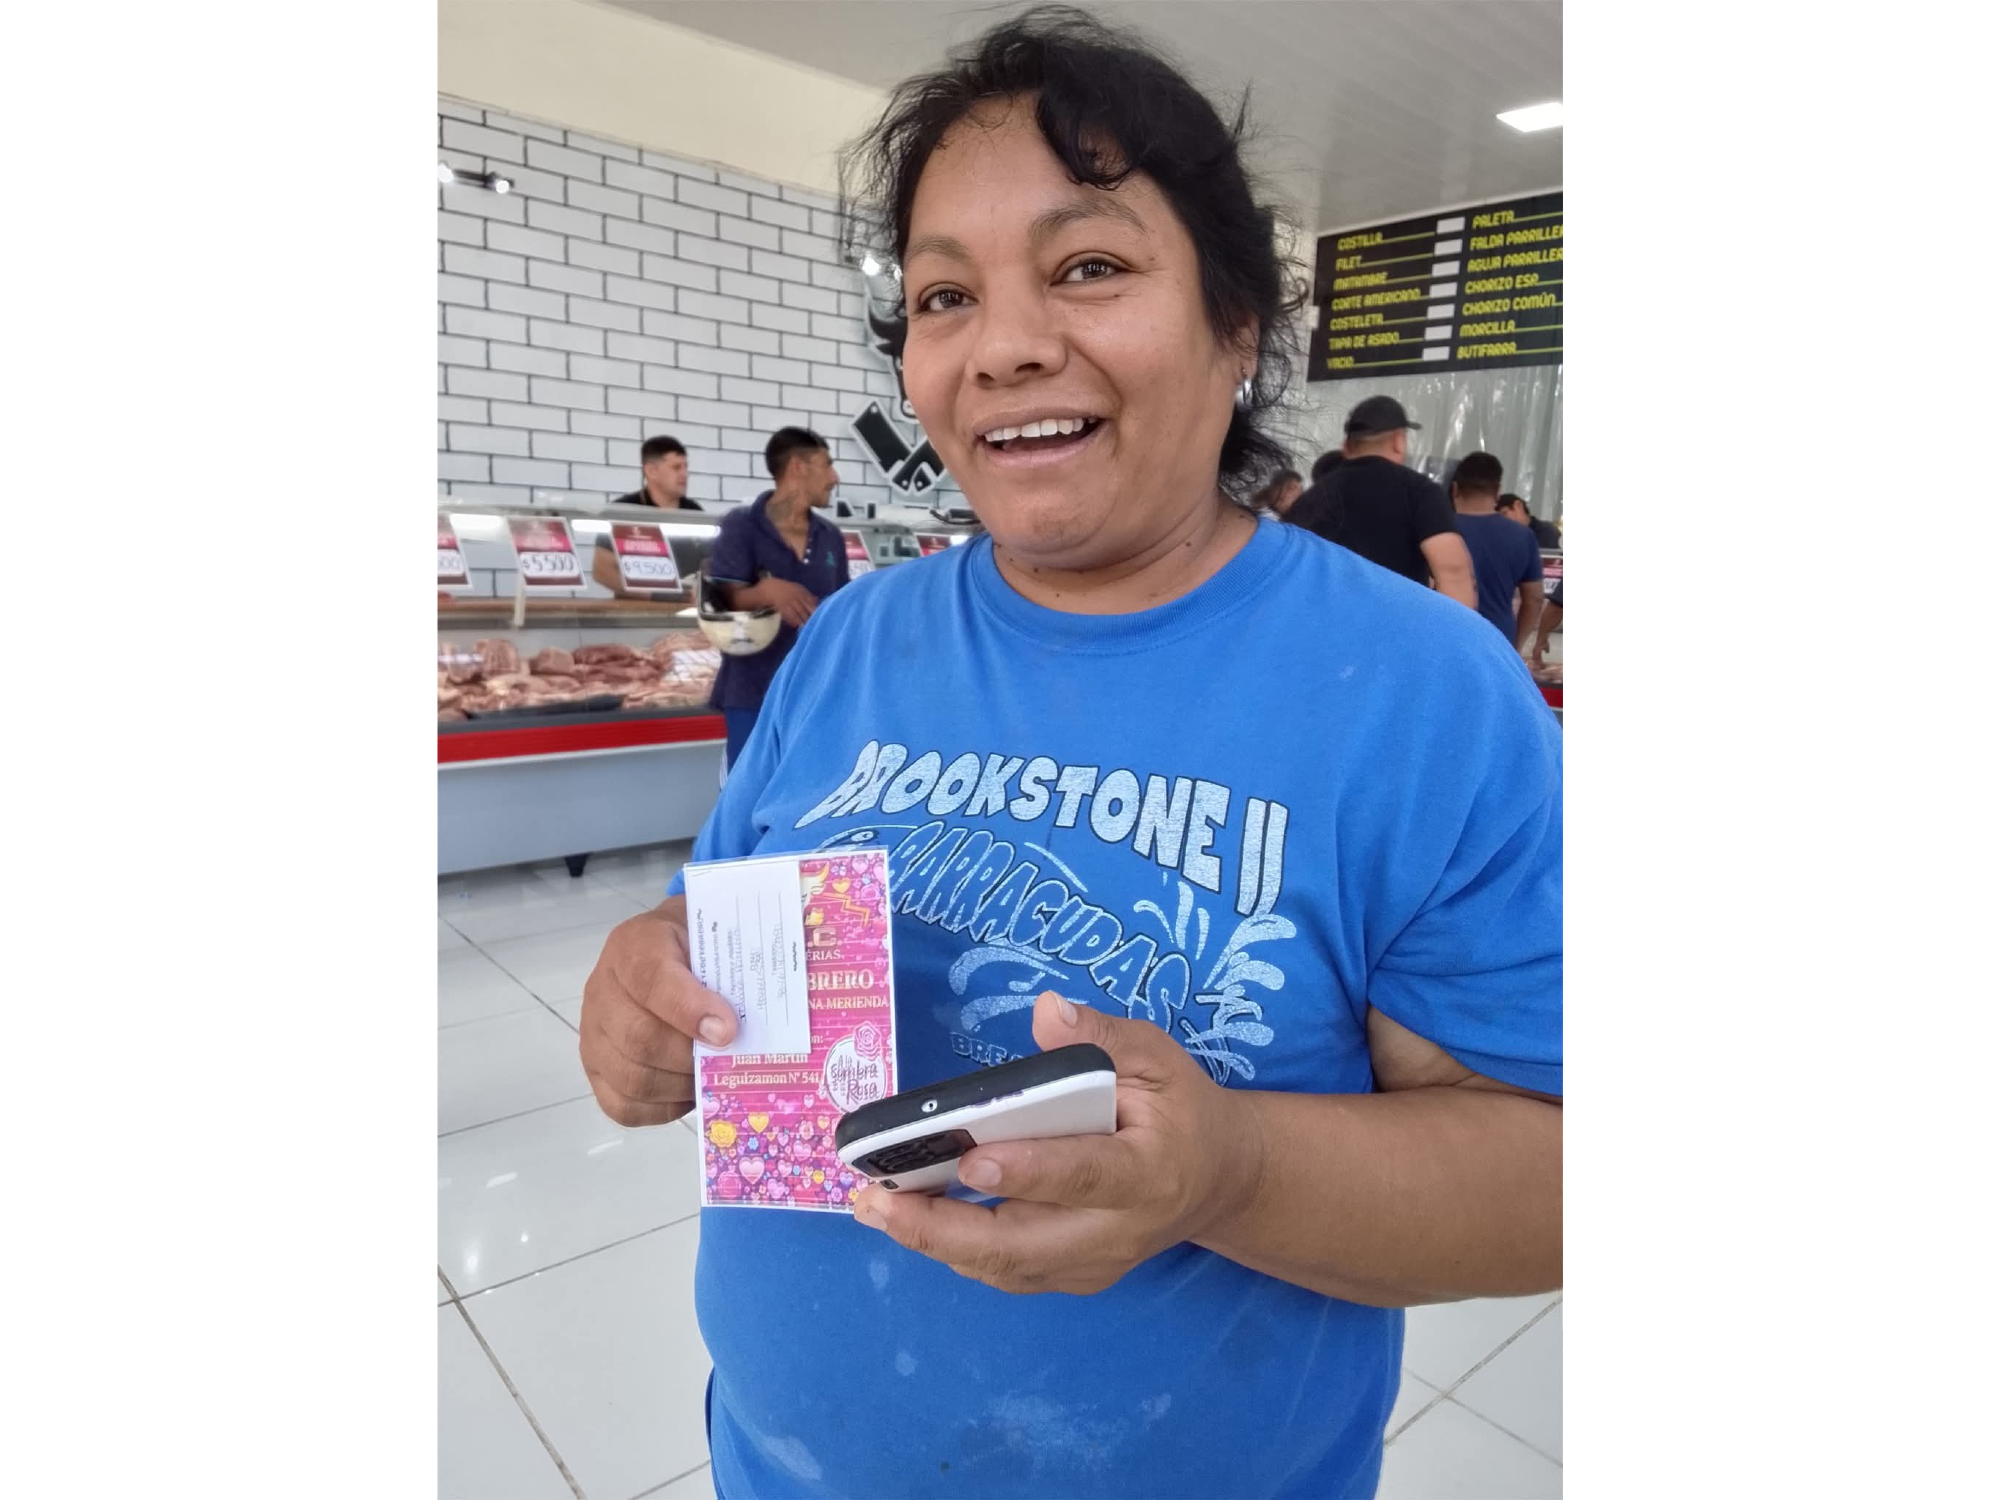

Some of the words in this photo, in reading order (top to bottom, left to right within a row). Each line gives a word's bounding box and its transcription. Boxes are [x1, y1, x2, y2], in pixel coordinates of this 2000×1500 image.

[1472, 210, 1515, 229] PALETA
[1337, 231, 1383, 251] COSTILLA
[1469, 233, 1504, 251] FALDA
[1335, 255, 1363, 271] FILET
[1464, 276, 1513, 295] CHORIZO
[1331, 295, 1363, 312] CORTE
[1363, 287, 1421, 307] AMERICANO
[1462, 298, 1511, 317] CHORIZO
[1330, 312, 1383, 331] COSTELETA
[1460, 319, 1515, 337] MORCILLA
[1328, 336, 1352, 350] TAPA
[1353, 334, 1366, 348] DE
[1366, 331, 1400, 348] ASADO
[1457, 341, 1516, 360] BUTIFARRA
[795, 739, 1231, 894] BROOKSTONE
[826, 995, 889, 1009] MERIENDA
[713, 1071, 786, 1089] Leguizamon
[802, 1071, 819, 1083] 541
[846, 1078, 880, 1105] Rosa
